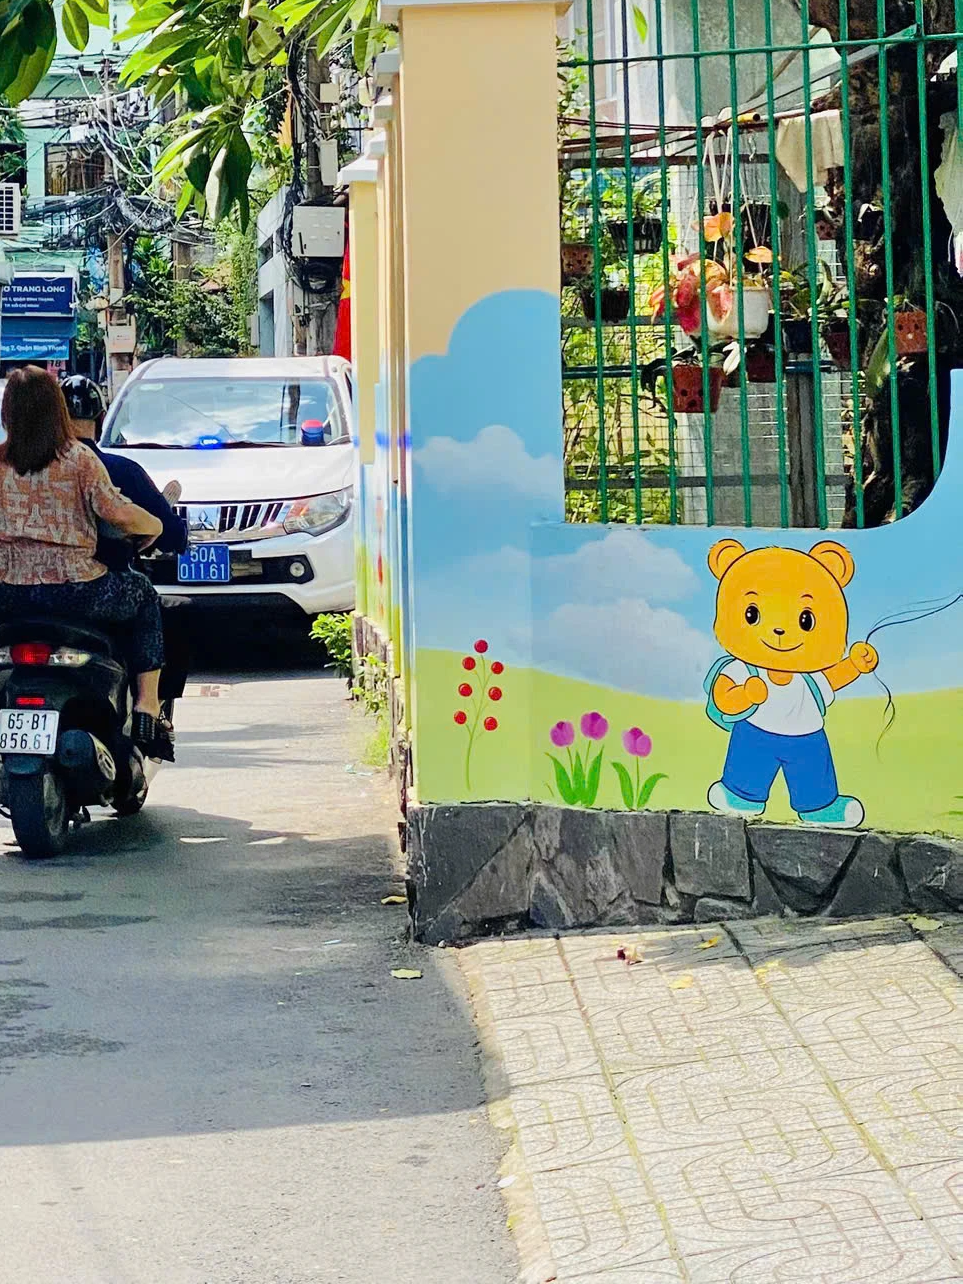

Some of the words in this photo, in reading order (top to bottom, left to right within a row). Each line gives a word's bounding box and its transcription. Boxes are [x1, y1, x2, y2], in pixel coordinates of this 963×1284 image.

[11, 285, 41, 293] TRANG
[42, 285, 66, 293] LONG
[190, 546, 217, 563] 50A
[180, 563, 225, 580] 011.61
[0, 733, 51, 750] 856.61
